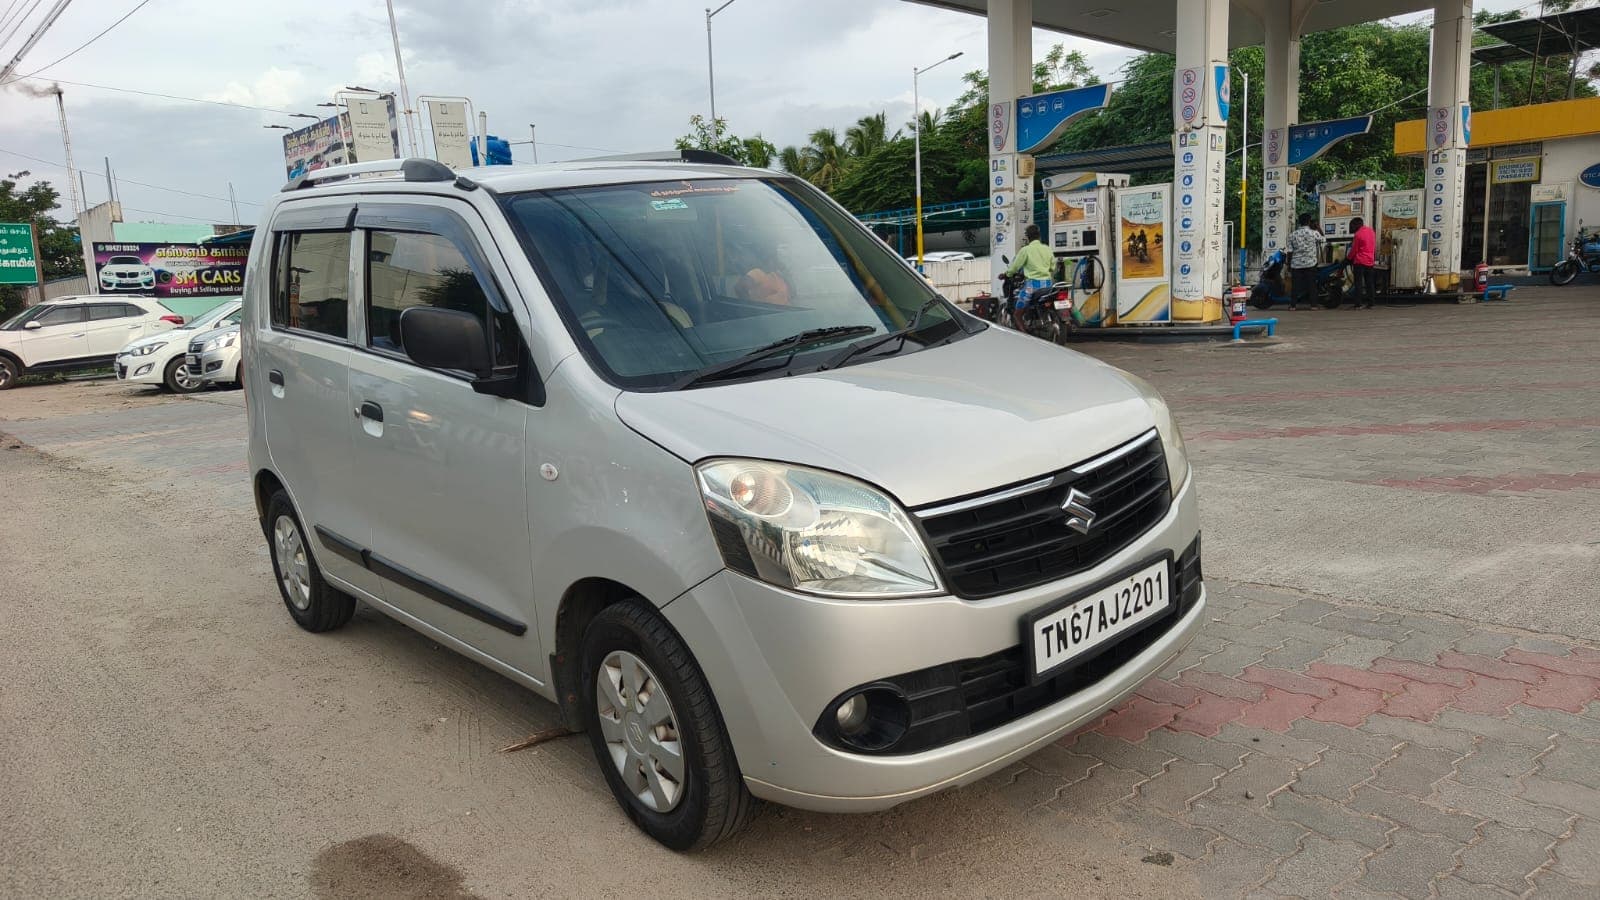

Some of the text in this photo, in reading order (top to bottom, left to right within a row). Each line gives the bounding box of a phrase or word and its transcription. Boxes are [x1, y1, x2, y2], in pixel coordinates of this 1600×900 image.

[175, 269, 241, 285] SM CARS
[170, 286, 192, 295] Buying
[199, 286, 219, 294] Selling
[1041, 571, 1163, 658] TN67AJ2201
